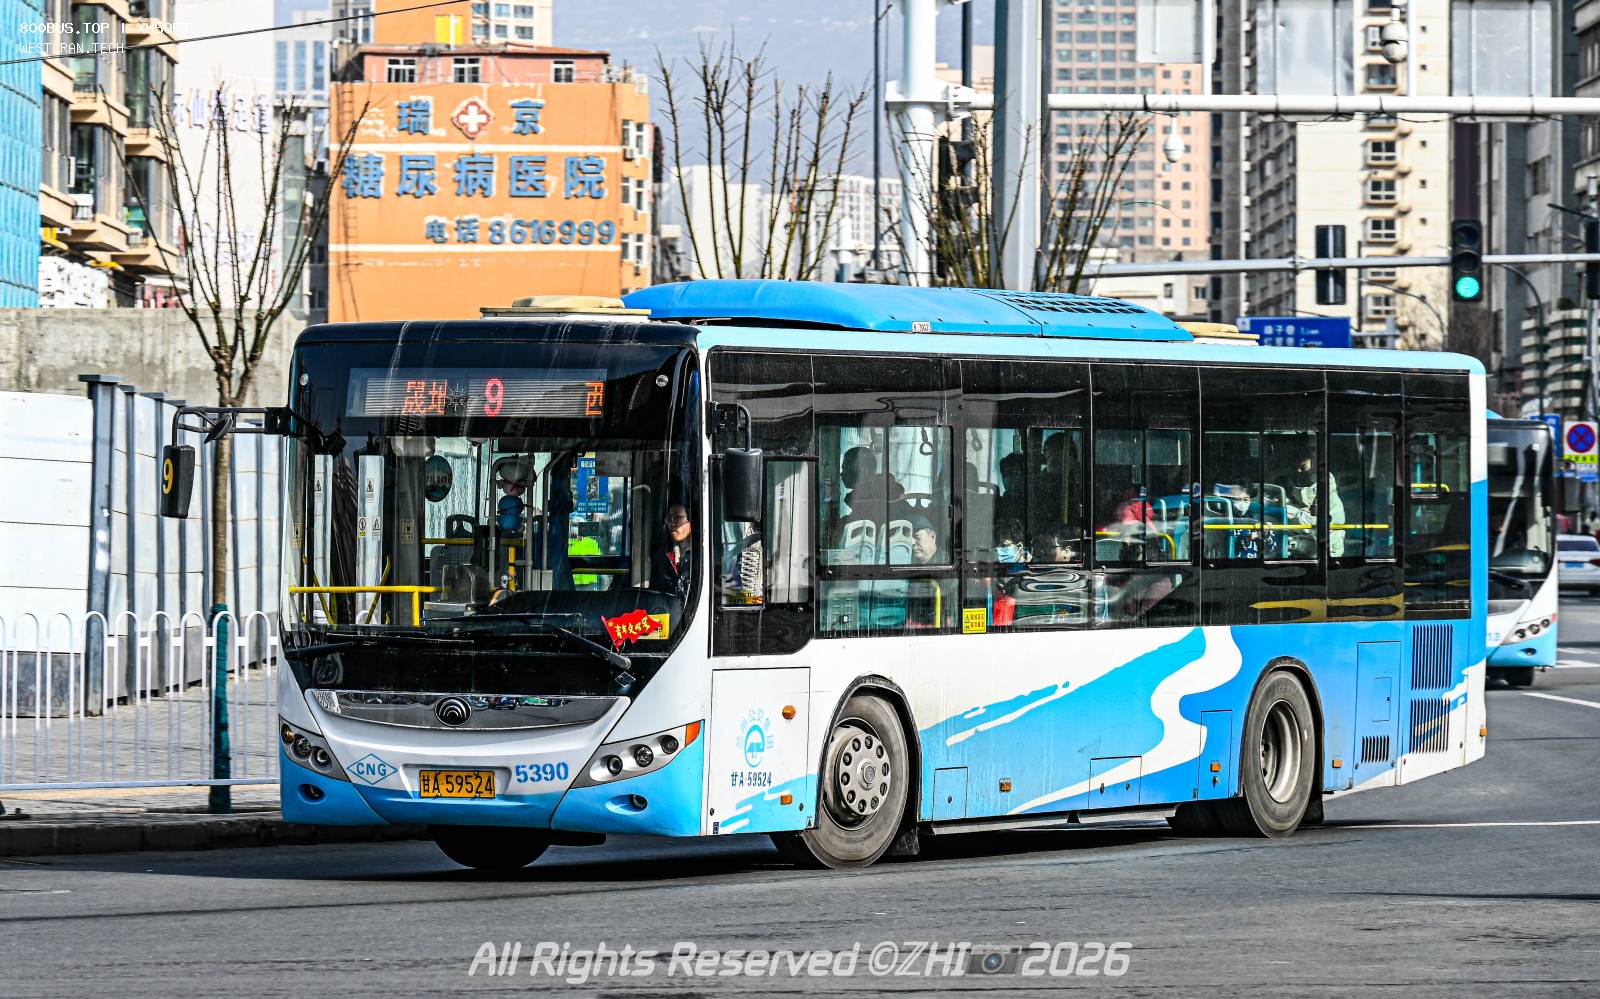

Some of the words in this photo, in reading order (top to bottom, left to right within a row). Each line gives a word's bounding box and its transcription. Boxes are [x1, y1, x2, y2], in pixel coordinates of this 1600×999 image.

[342, 153, 606, 199] 糖尿病医院
[483, 375, 505, 417] 9
[162, 458, 174, 495] 9
[356, 762, 388, 777] CNG
[515, 761, 569, 784] 5390
